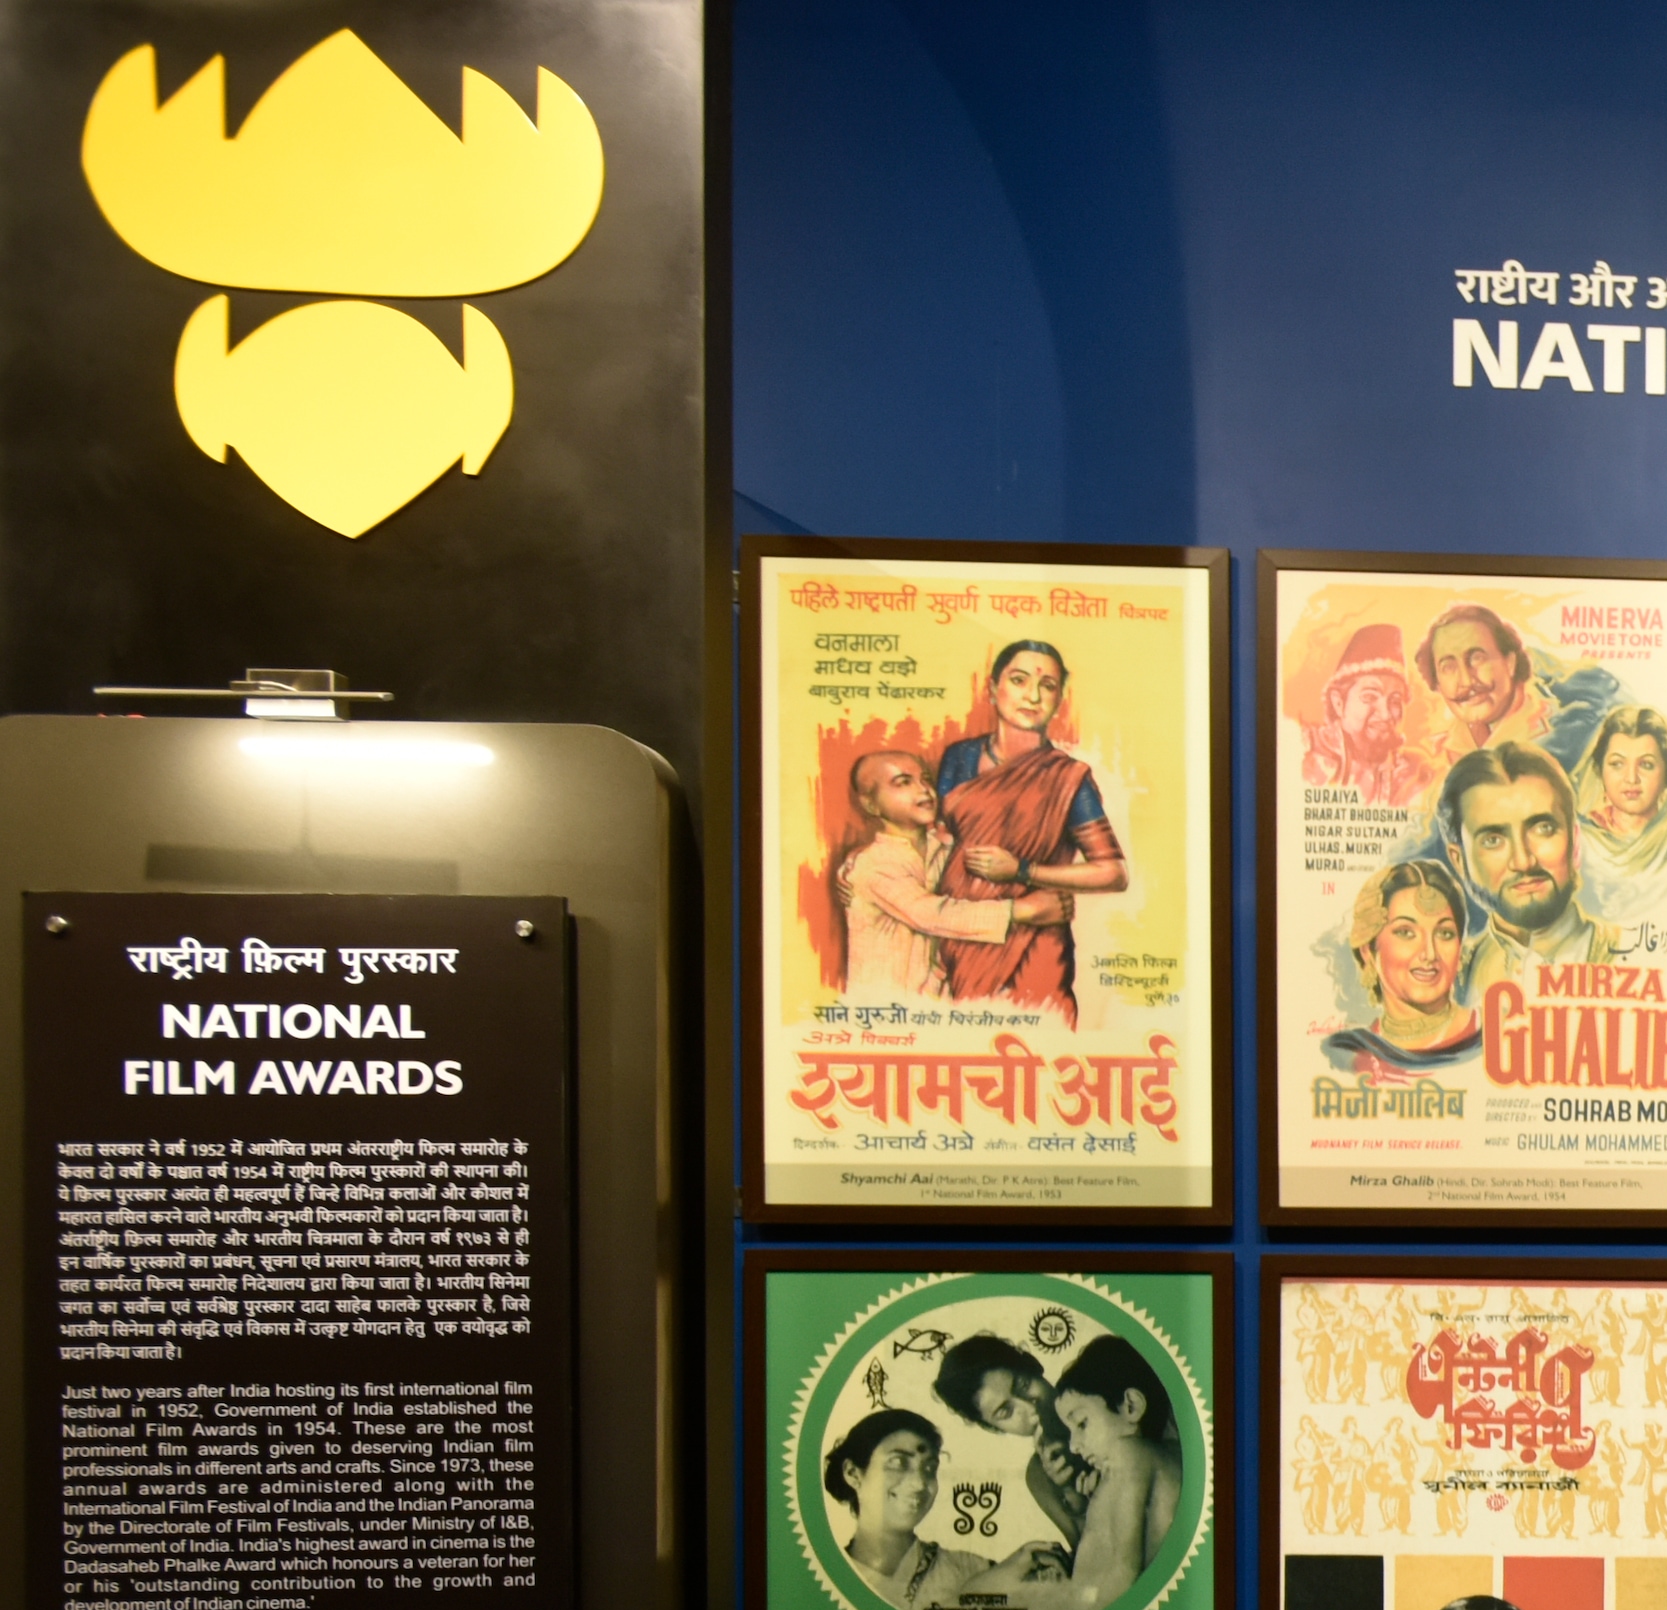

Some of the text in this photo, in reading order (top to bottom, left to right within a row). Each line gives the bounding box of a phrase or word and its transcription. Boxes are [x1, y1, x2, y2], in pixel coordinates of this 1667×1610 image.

[1569, 261, 1636, 309] और
[790, 581, 839, 613] पहिले
[989, 594, 1042, 619] पदक
[1561, 605, 1663, 632] MINERVA
[814, 633, 900, 652] वनमाला
[1560, 631, 1663, 647] MOVIETONE
[1304, 789, 1359, 804] SURAIYA
[1304, 808, 1409, 823] BHARAT BHOOSHAN
[1305, 825, 1398, 839] NIGAR SULTANA
[1304, 858, 1345, 873] MURAD
[1322, 882, 1335, 896] IN
[128, 937, 228, 980] राष्ट्रीय
[339, 947, 459, 984] पुरस्कार
[1537, 962, 1666, 1002] MIRZA
[161, 1004, 426, 1039] NATIONAL
[123, 1060, 464, 1096] FILM AWARDS
[789, 1031, 1179, 1143] श्यामची आई
[1383, 1078, 1467, 1119] गालिब
[1543, 1097, 1632, 1123] SOHRAB
[854, 1131, 927, 1151] आचार्य
[1517, 1133, 1579, 1152] GHULAM
[840, 1172, 934, 1187] Shyamchi Aai
[1349, 1174, 1434, 1187] Mirza Ghalib
[61, 1380, 533, 1402] Just two years after India hosting its first international film
[61, 1398, 534, 1419] festival in 1952, Government of India established the
[62, 1419, 534, 1438] National Film Awards in 1954. These are the most
